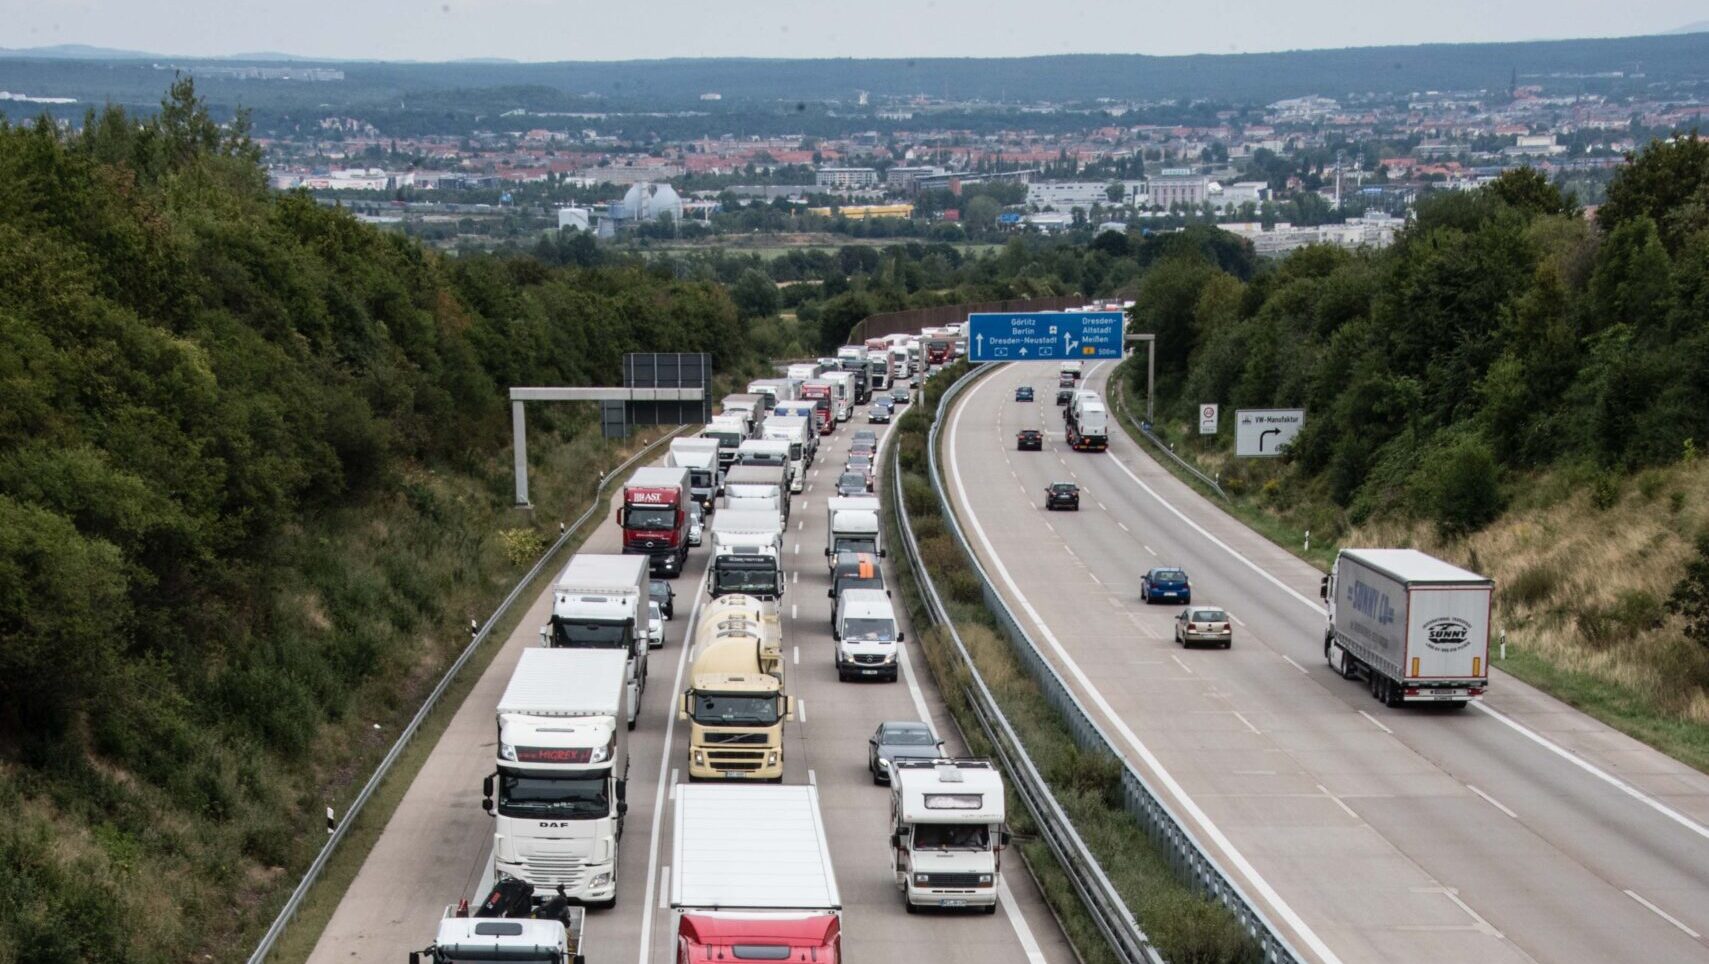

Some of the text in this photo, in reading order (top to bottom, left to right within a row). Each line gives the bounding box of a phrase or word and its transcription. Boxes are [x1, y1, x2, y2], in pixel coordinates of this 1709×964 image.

[1011, 318, 1036, 326] Görlitz
[1082, 317, 1116, 325] Dresden-
[1012, 327, 1035, 335] Berlin
[1082, 326, 1112, 334] Altstadt
[989, 336, 1057, 345] Dresden-Neustadt
[1082, 335, 1109, 343] Meißen
[1428, 630, 1468, 638] SUNNY
